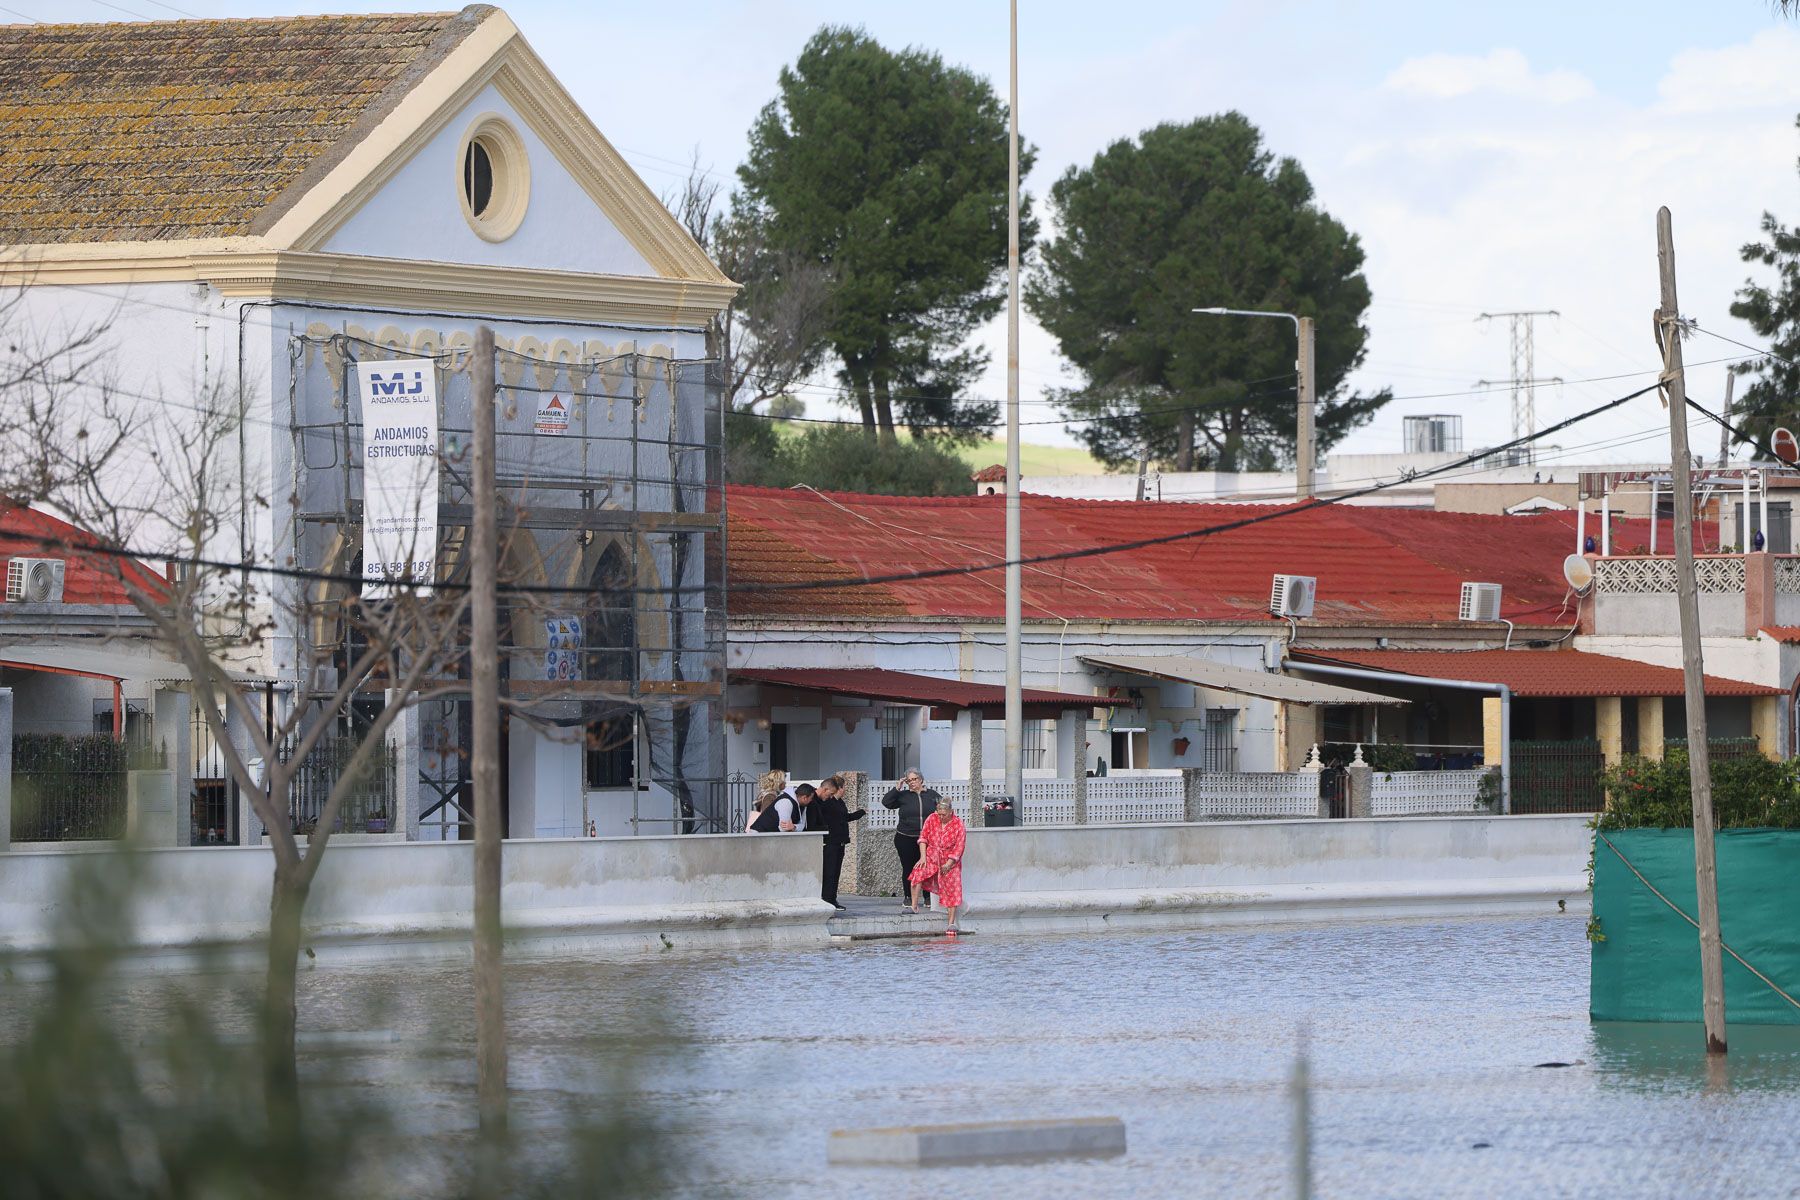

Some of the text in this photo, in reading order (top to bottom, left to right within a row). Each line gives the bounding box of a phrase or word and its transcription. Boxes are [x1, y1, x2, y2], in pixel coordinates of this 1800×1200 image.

[371, 372, 422, 395] MJ
[374, 427, 428, 440] ANDAMIOS
[368, 445, 434, 458] ESTRUCTURAS
[368, 526, 433, 534] info@mjandamios.com
[368, 563, 387, 573] 856
